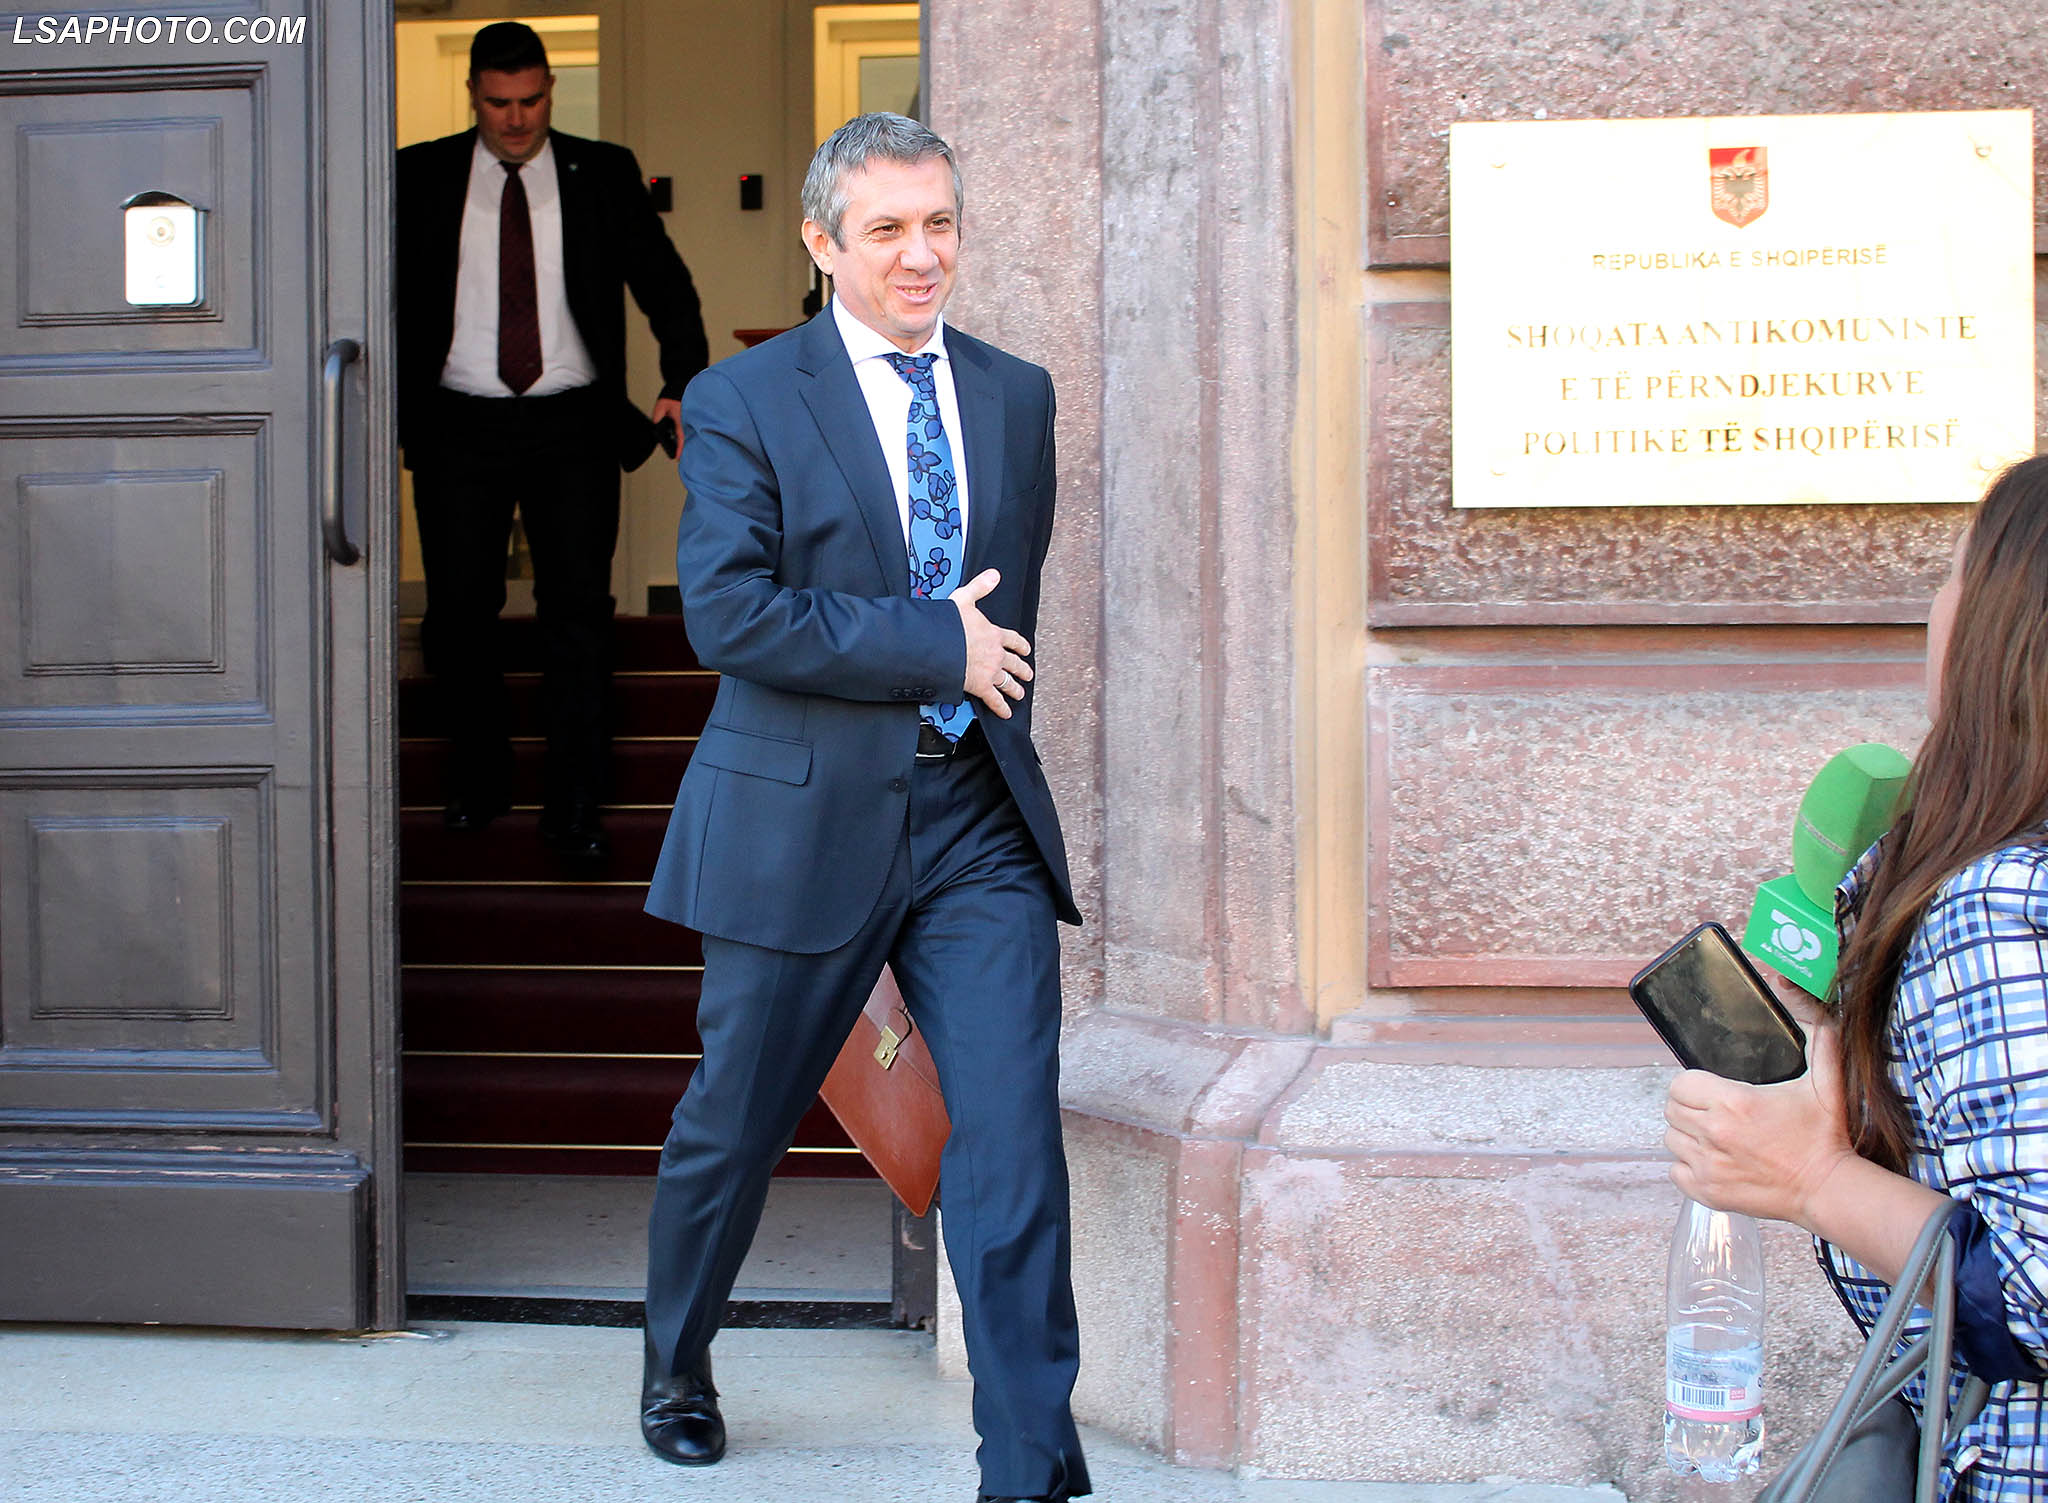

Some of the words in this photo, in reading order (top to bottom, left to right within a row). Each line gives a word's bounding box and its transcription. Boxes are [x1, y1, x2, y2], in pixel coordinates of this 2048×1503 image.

[1592, 251, 1721, 270] REPUBLIKA
[1730, 250, 1742, 268] E
[1751, 244, 1887, 267] SHQIPËRISË
[1507, 323, 1669, 352] SHOQATA
[1678, 315, 1977, 346] ANTIKOMUNISTE
[1560, 377, 1577, 400] E
[1591, 370, 1633, 400] TË
[1646, 369, 1925, 400] PËRNDJEKURVE
[1523, 428, 1689, 455] POLITIKE
[1699, 421, 1743, 452] TË
[1753, 418, 1961, 456] SHQIPËRISË
